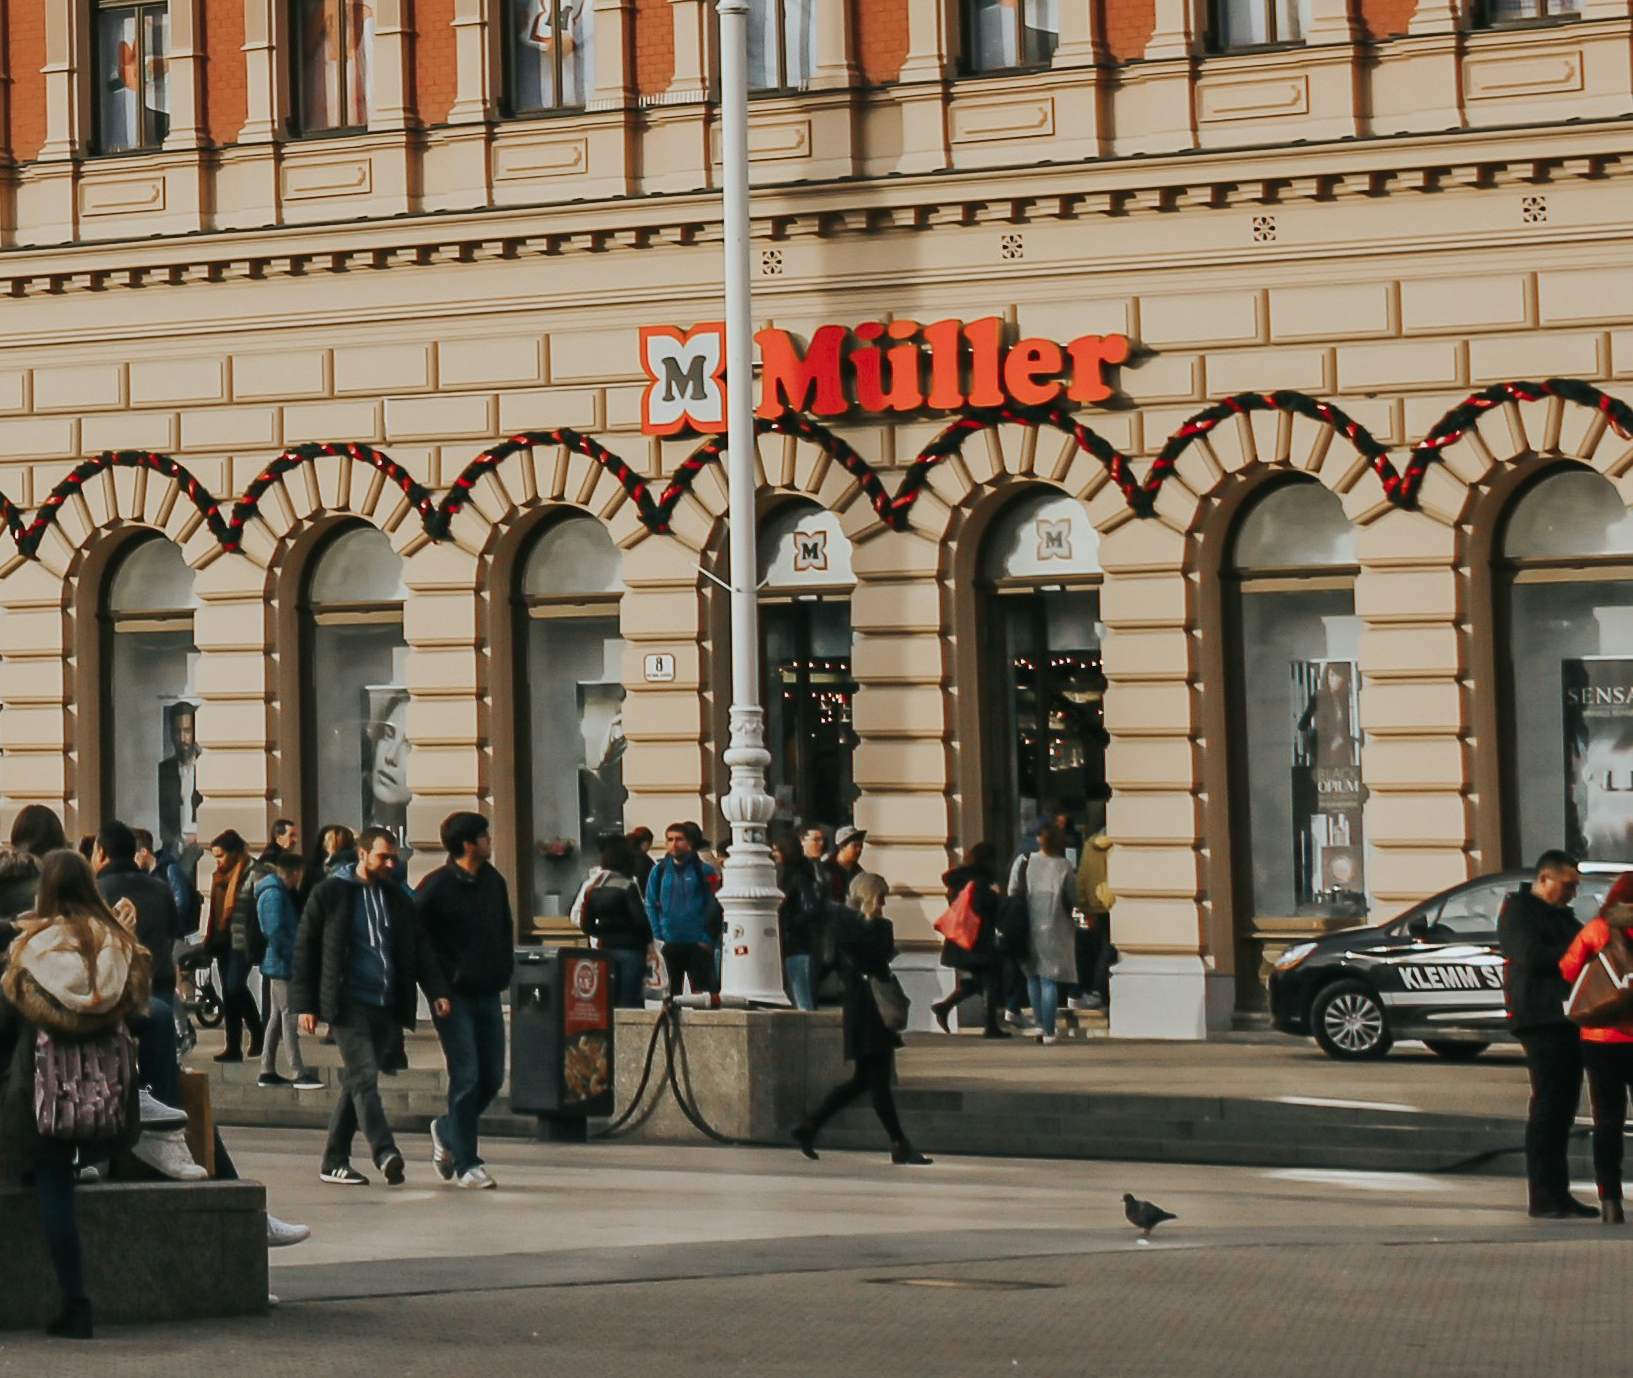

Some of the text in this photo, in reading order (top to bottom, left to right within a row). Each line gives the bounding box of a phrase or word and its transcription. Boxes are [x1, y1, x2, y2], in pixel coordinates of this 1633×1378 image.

[662, 317, 1129, 419] M Müller
[1045, 531, 1063, 550] M
[802, 542, 819, 560] M
[655, 656, 663, 672] 8
[1317, 780, 1360, 793] OPIUM
[1397, 965, 1482, 990] KLEMM
